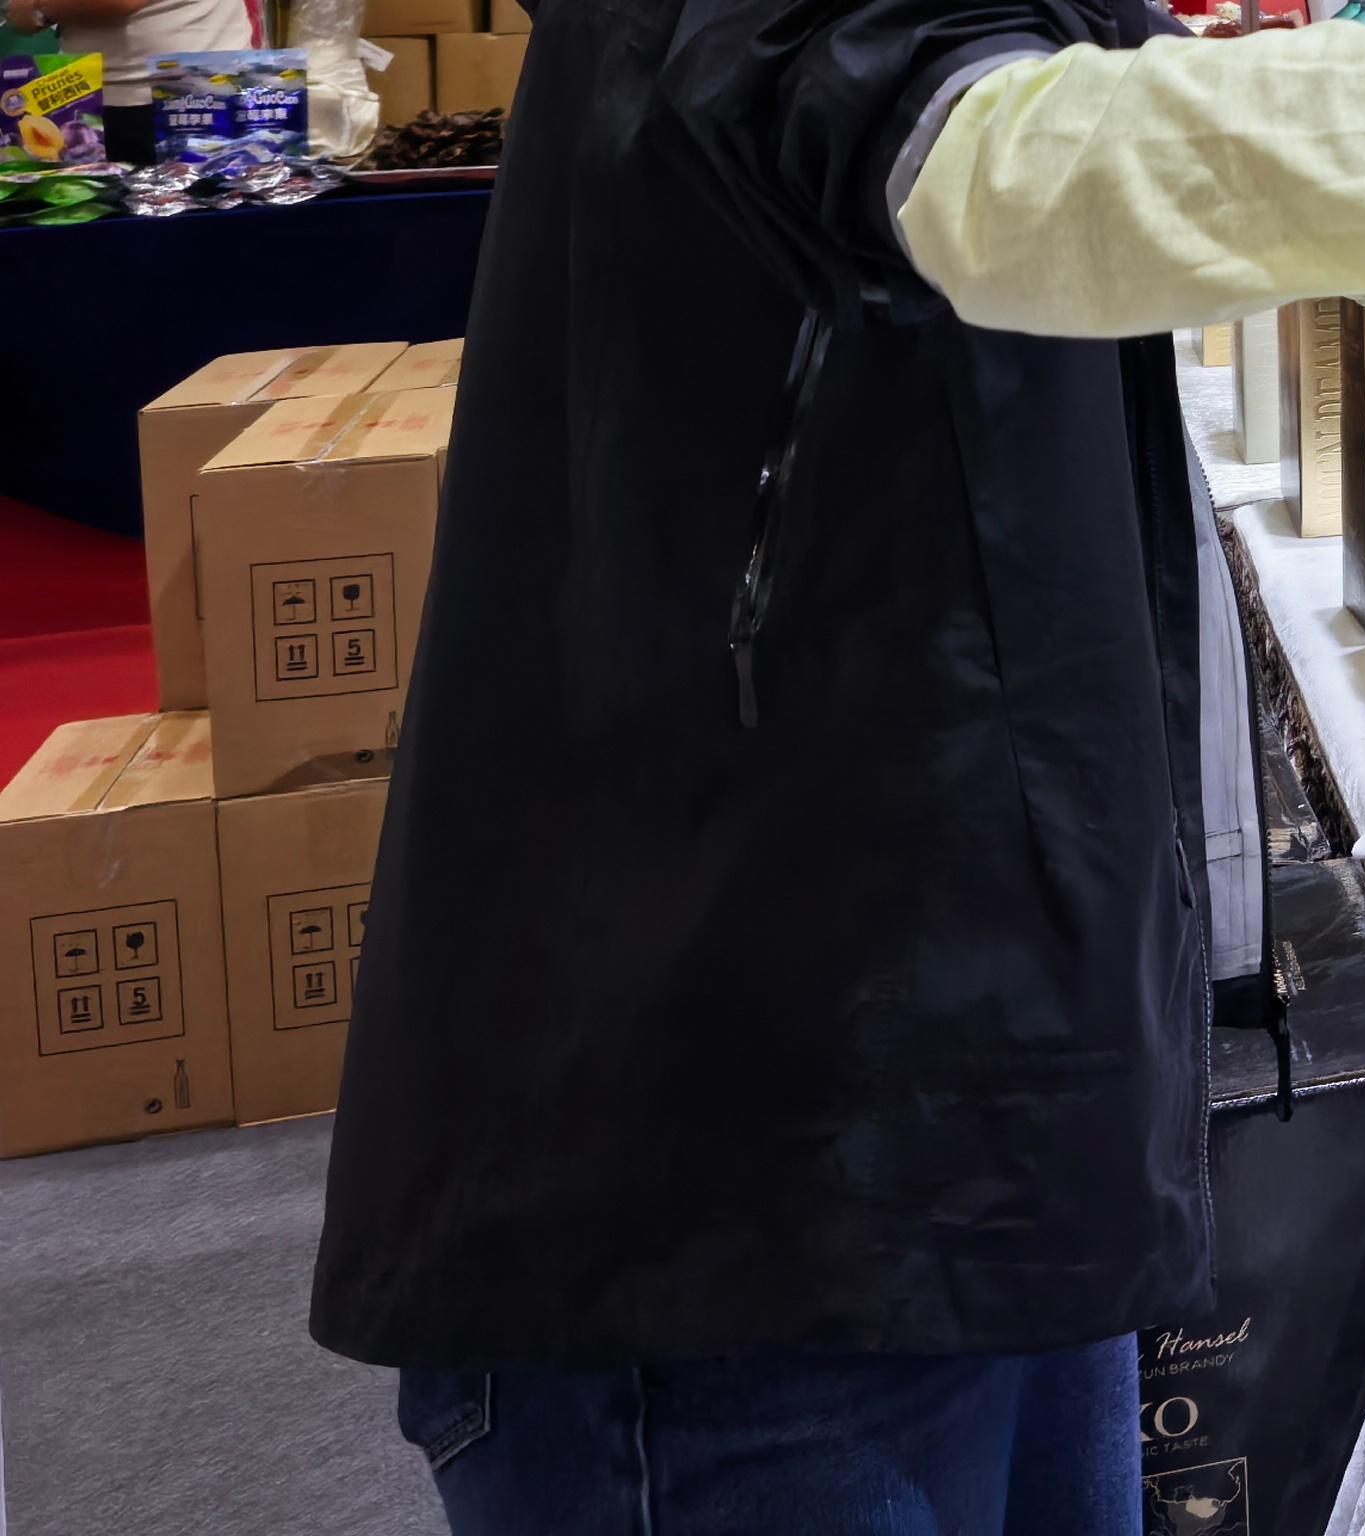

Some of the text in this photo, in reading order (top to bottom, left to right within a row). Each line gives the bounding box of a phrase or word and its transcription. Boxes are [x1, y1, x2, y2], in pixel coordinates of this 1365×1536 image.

[31, 70, 84, 100] Prunes
[1156, 1317, 1250, 1359] Hansel
[1139, 1353, 1235, 1381] UN BRANDY
